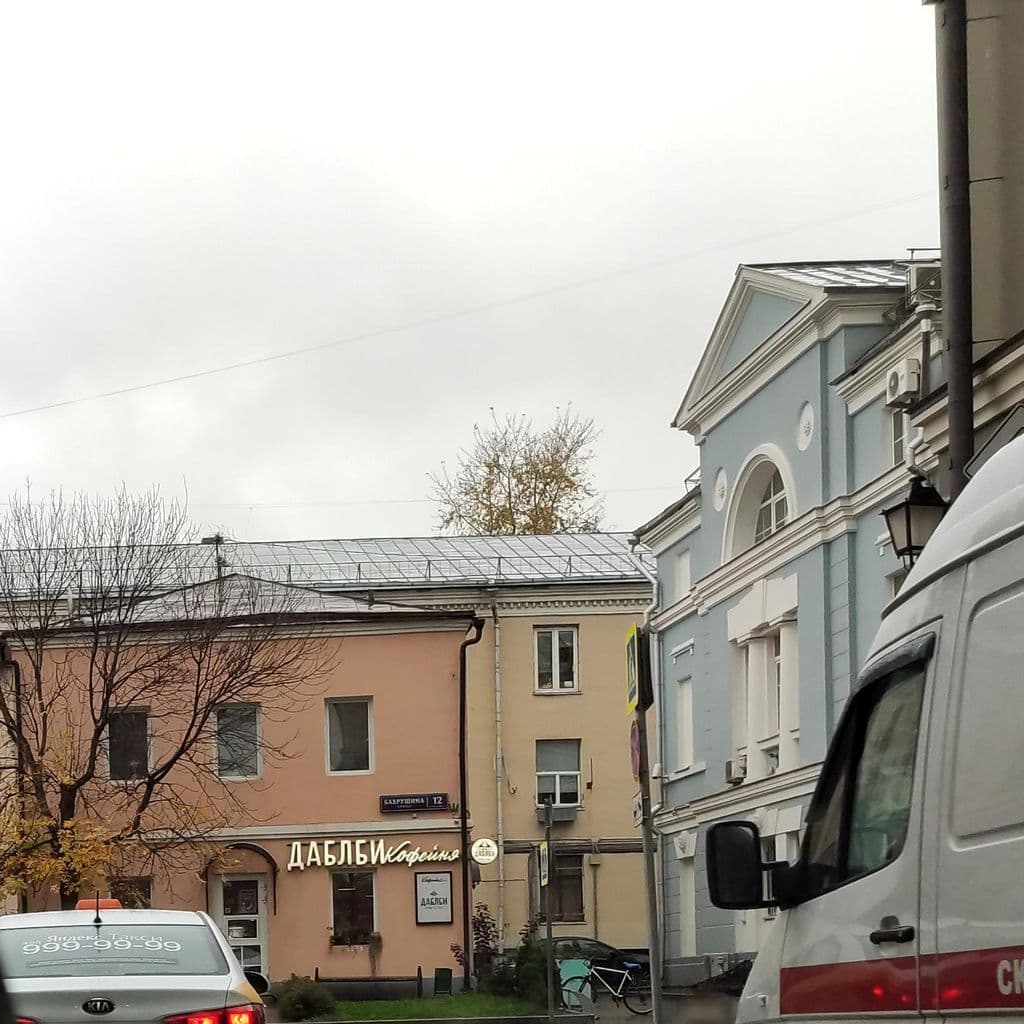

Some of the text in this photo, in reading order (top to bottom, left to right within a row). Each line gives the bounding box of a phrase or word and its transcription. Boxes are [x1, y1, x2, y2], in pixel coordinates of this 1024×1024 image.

[383, 796, 444, 805] БАХРУШИНА 12
[287, 839, 460, 871] ДАБЛБИ Кофейня
[420, 897, 448, 906] ДАБЛБИ
[22, 939, 182, 955] 999-99-99
[87, 1001, 110, 1012] KIA
